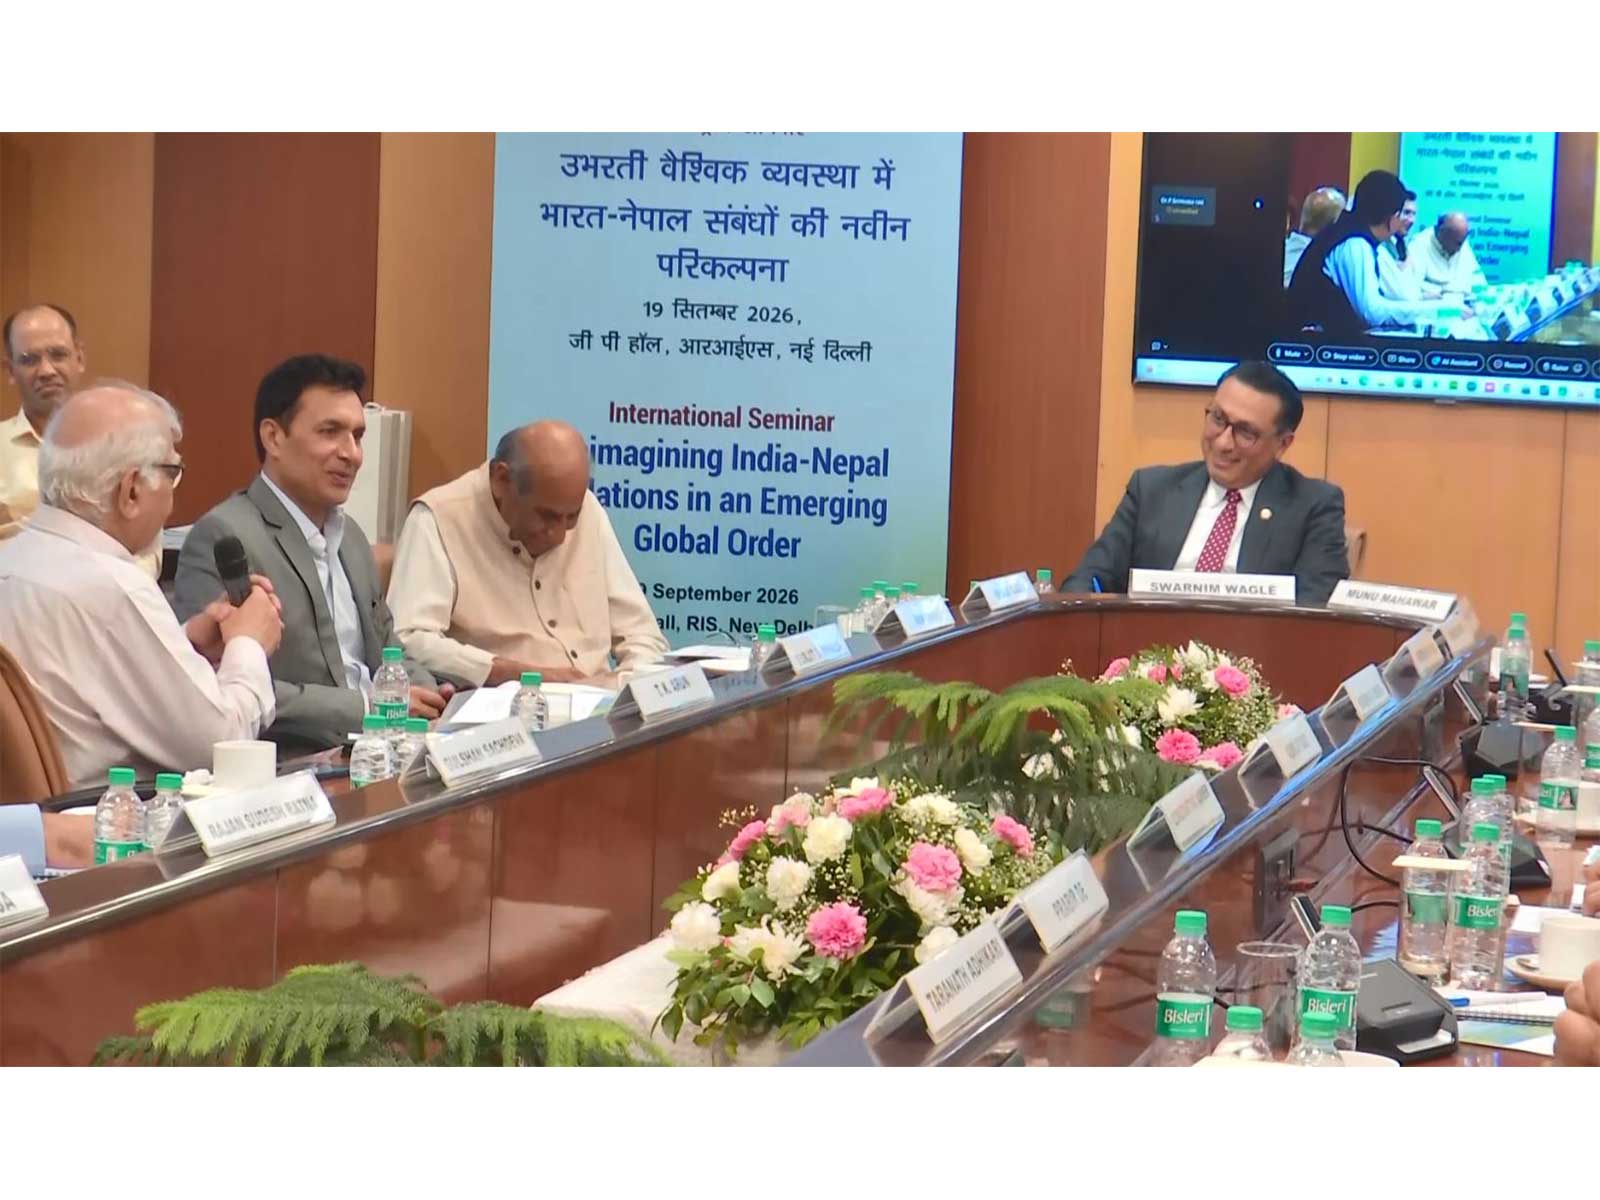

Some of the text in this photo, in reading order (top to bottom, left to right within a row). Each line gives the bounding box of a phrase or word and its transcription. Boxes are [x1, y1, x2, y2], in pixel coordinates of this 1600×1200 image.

[560, 149, 895, 190] उभरती वैश्विक व्यवस्था में
[540, 198, 911, 241] भारत-नेपाल संबंधों की नवीन
[656, 248, 789, 282] परिकल्पना
[643, 298, 802, 326] 19 सितम्बर 2026,
[568, 330, 593, 351] जी
[601, 331, 620, 352] पी
[790, 337, 814, 362] नई
[823, 340, 872, 362] दिल्ली
[610, 402, 836, 433] International Seminar
[590, 435, 889, 483] imagining India-Nepal
[688, 482, 710, 512] in
[720, 492, 751, 514] an
[761, 487, 887, 527] Emerging
[634, 523, 801, 559] Global Order
[653, 583, 751, 603] September
[757, 588, 799, 605] 2026
[1150, 582, 1277, 595] SWARNIM WAGLE
[656, 614, 680, 633] all,
[774, 619, 814, 636] Delh
[1467, 904, 1497, 918] Bisle
[1164, 1008, 1205, 1024] Bisleri
[1308, 998, 1346, 1013] Bisleri
